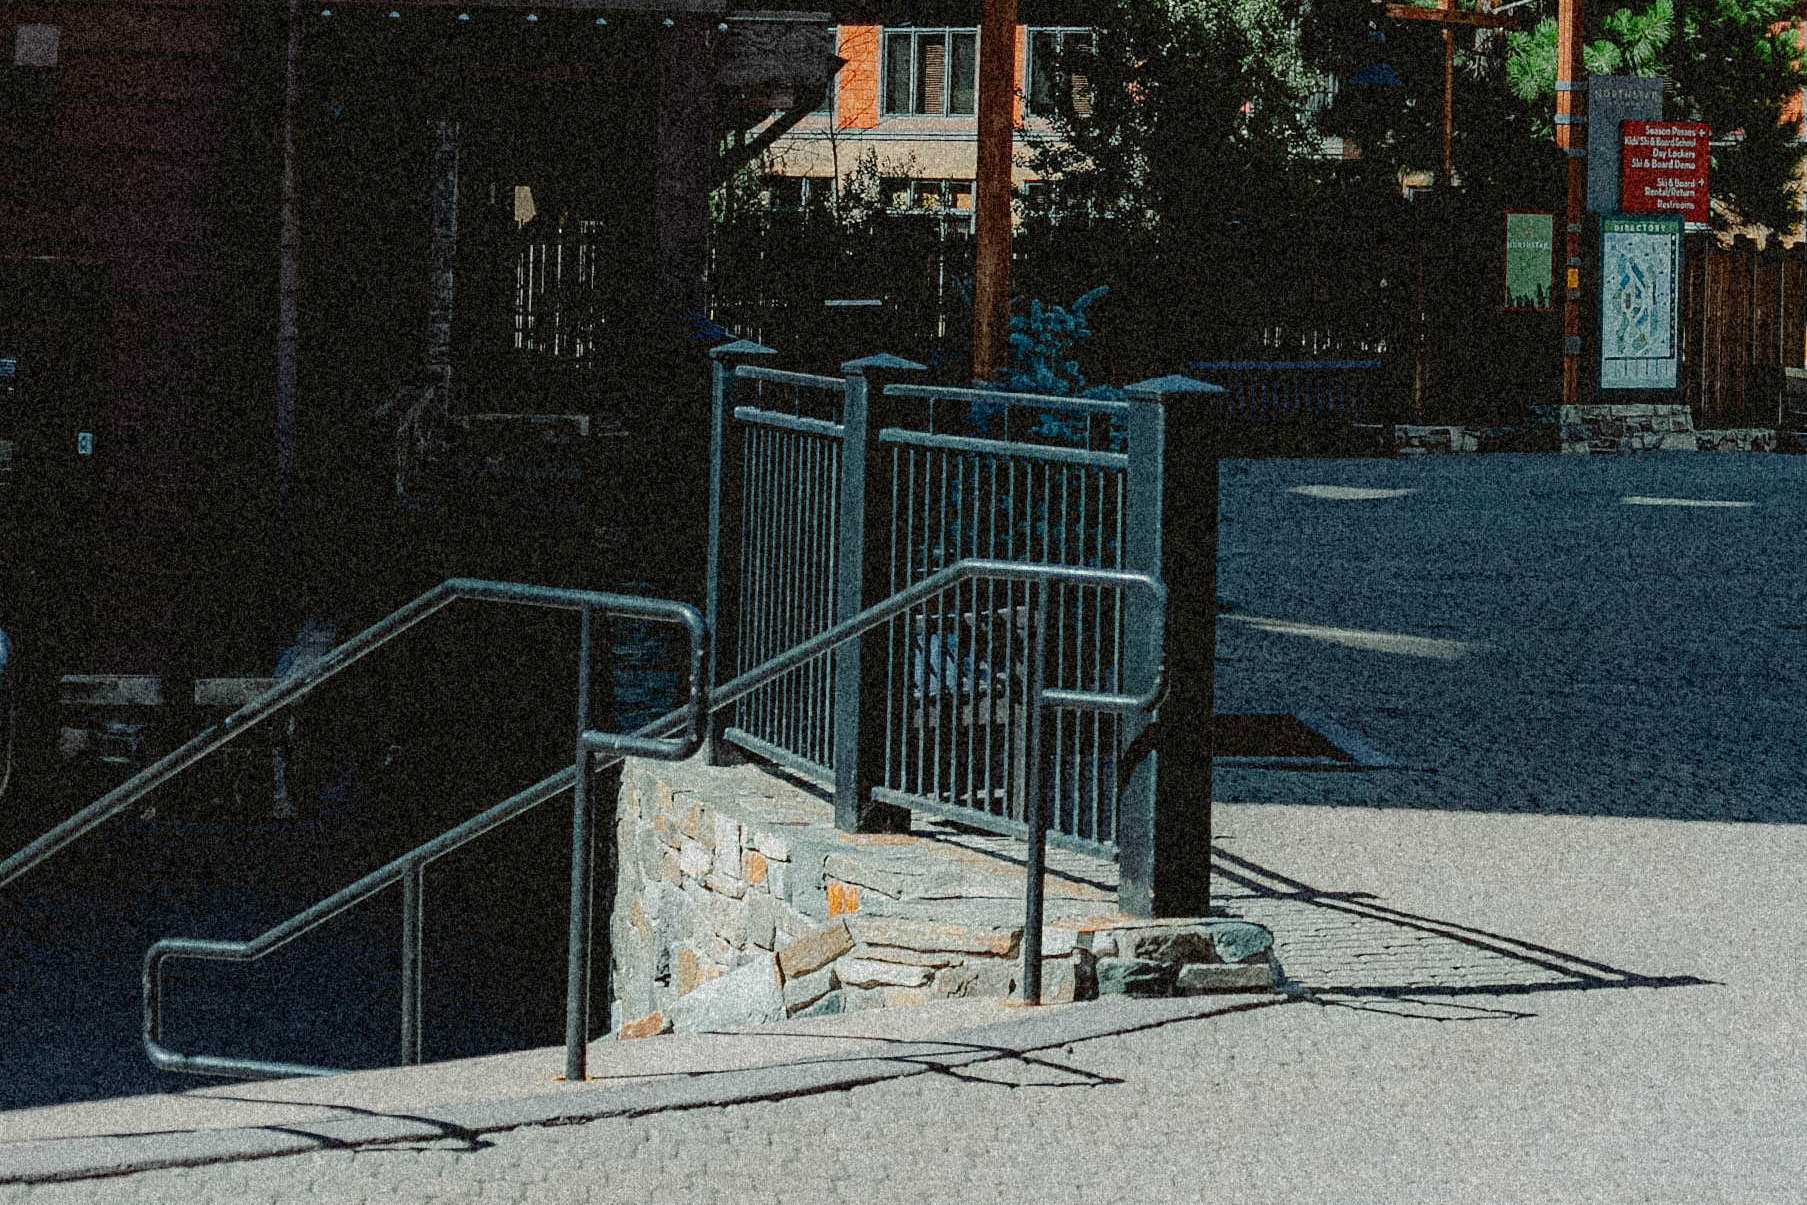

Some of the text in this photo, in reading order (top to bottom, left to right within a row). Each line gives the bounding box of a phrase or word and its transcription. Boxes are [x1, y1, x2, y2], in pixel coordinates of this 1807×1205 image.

[1645, 125, 1696, 136] Season Passes
[1656, 137, 1675, 146] Board
[1675, 137, 1696, 147] School
[1652, 148, 1696, 159] Day Lockers
[1631, 158, 1643, 168] Ski
[1651, 159, 1674, 169] Board
[1674, 160, 1696, 169] Demo
[1657, 177, 1667, 187] Ski
[1674, 178, 1696, 188] Board
[1645, 186, 1695, 197] Rental/Return
[1657, 199, 1695, 209] Restrooms
[1614, 224, 1666, 232] DIRECTORY
